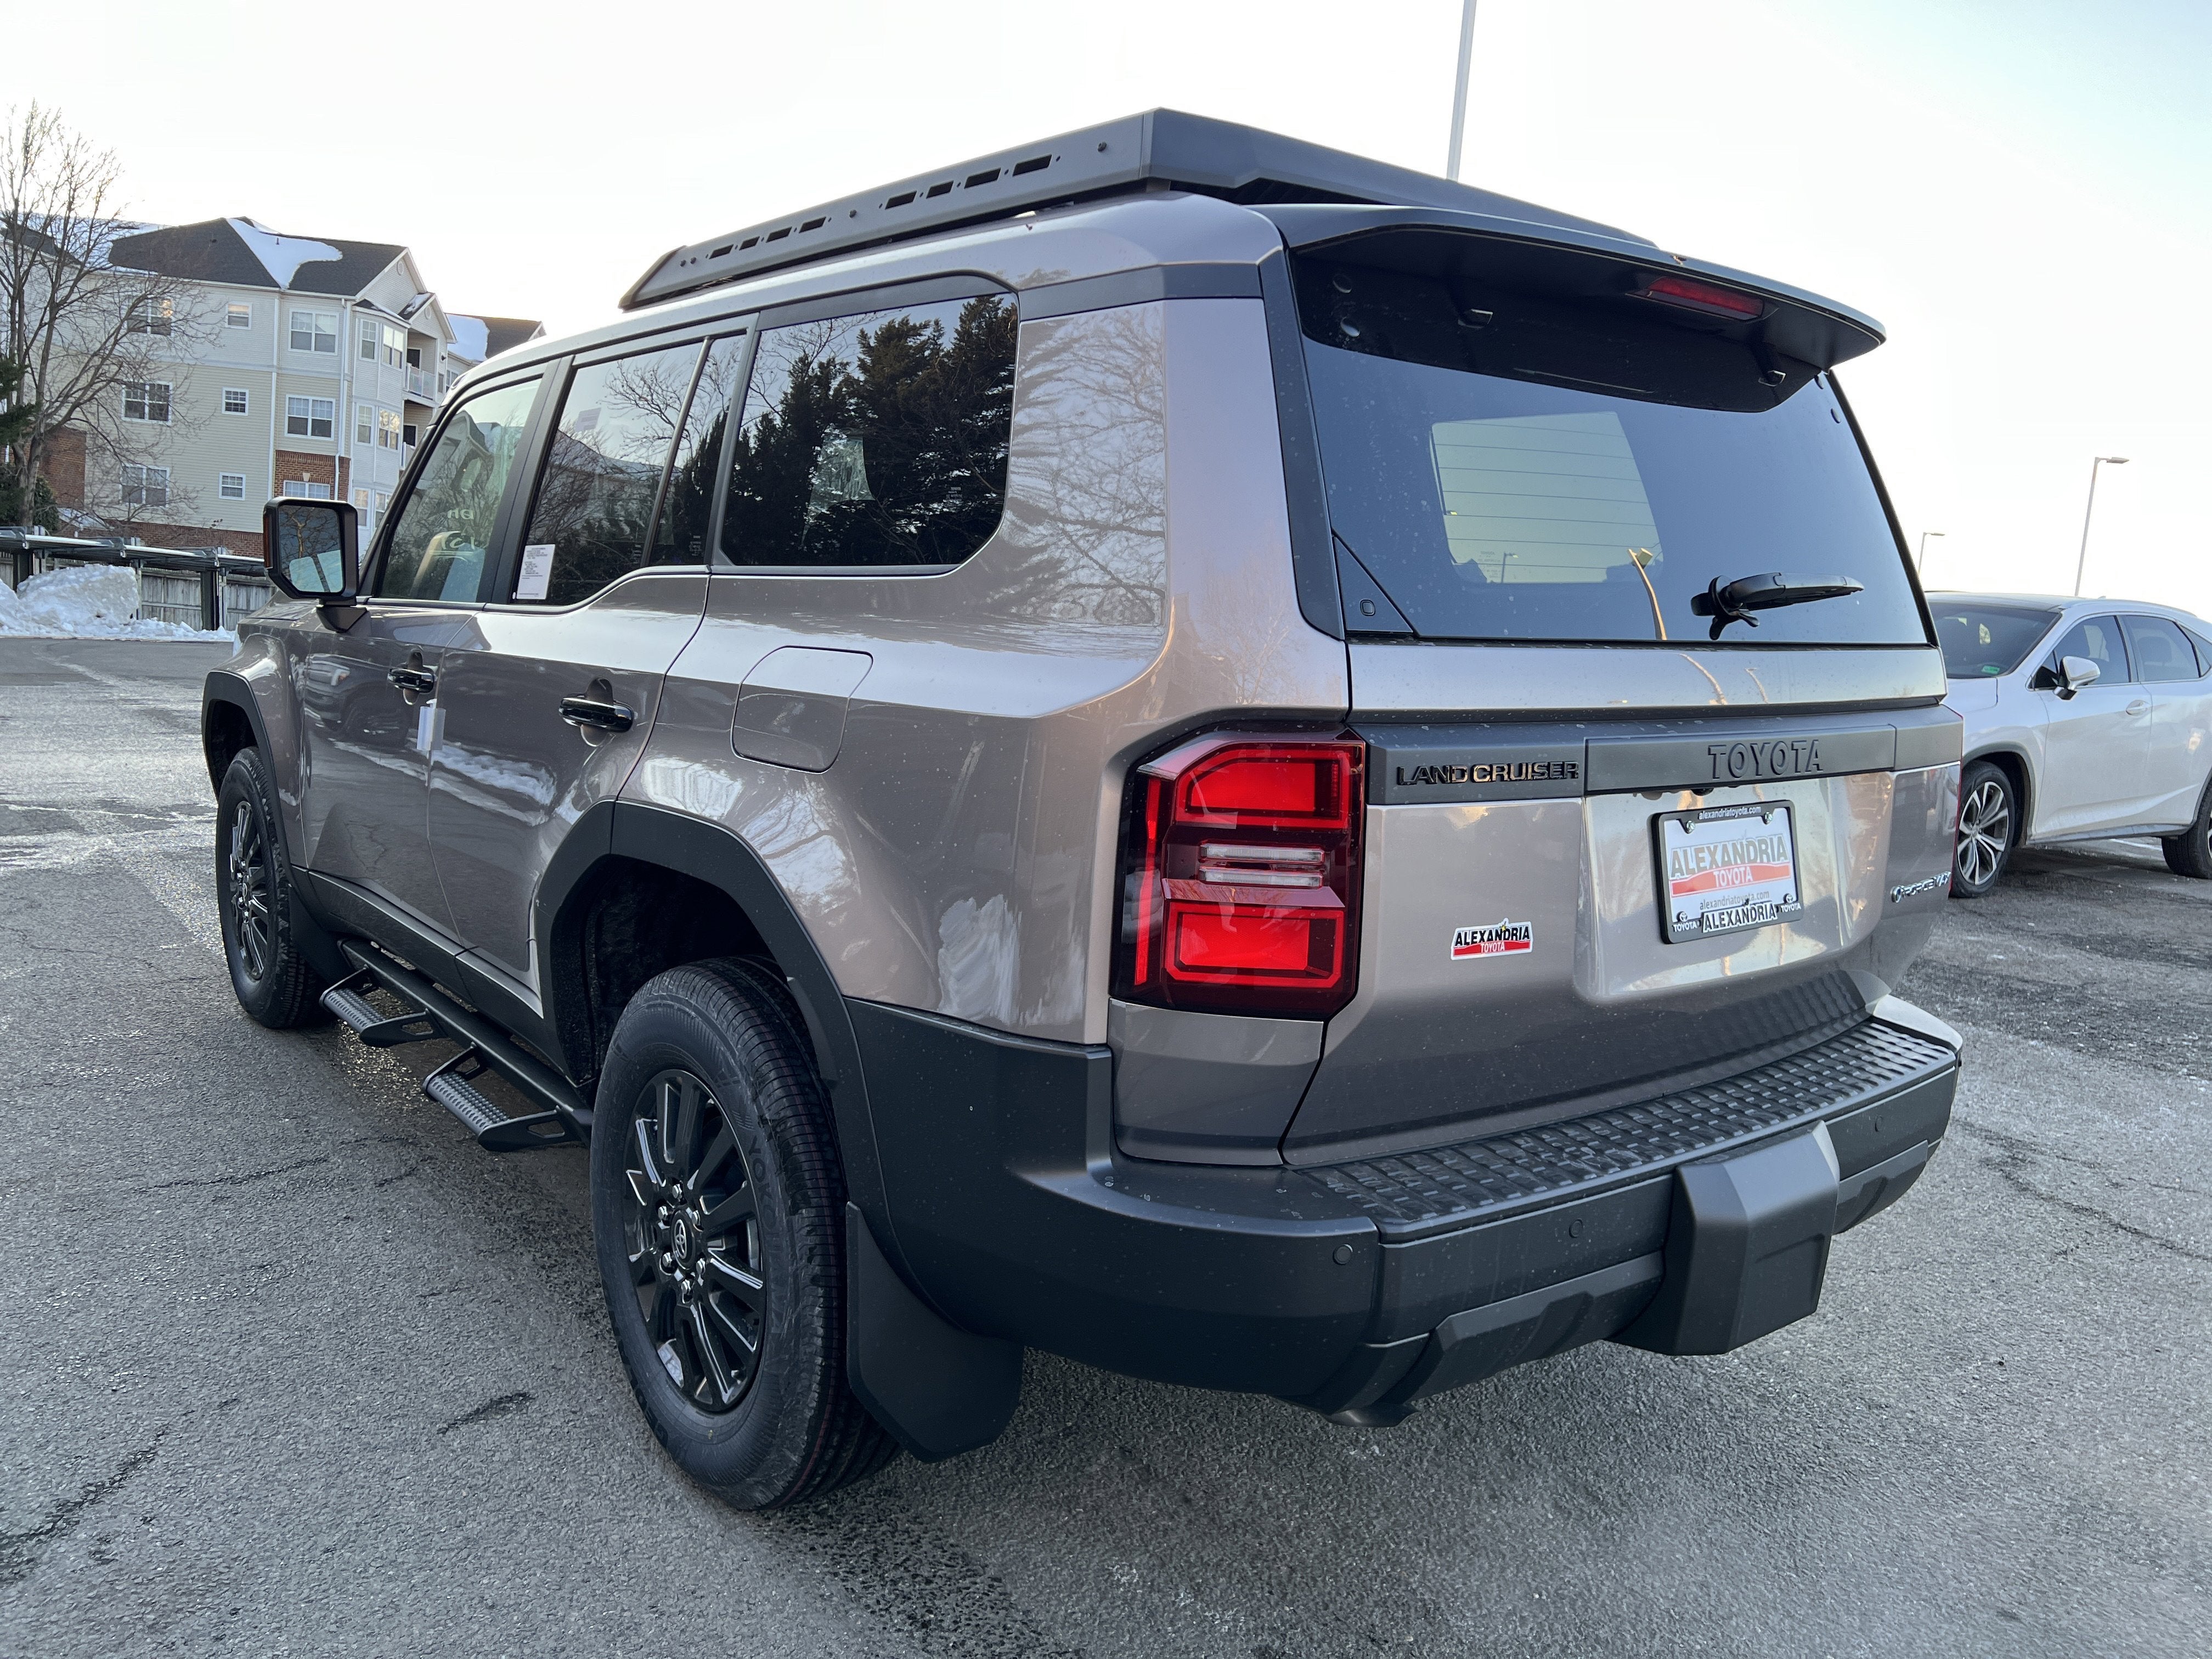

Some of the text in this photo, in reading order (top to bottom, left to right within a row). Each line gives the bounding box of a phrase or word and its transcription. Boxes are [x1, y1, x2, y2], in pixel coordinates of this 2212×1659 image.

[1707, 740, 1823, 780] TOYOTA
[1397, 761, 1579, 786] LAND CRUISER
[1699, 806, 1761, 820] alexandriatoyota.com
[1669, 834, 1789, 878] ALEXANDRIA
[1713, 867, 1753, 887] TOYOTA
[1700, 890, 1770, 910] alexandriatoyota.com
[1781, 902, 1802, 912] TOYOTA
[1673, 921, 1698, 932] TOYOTA
[1703, 904, 1778, 932] ALEXANDRIA
[1455, 926, 1530, 946] ALEXANDRIA
[1481, 941, 1505, 953] TOYOTA
